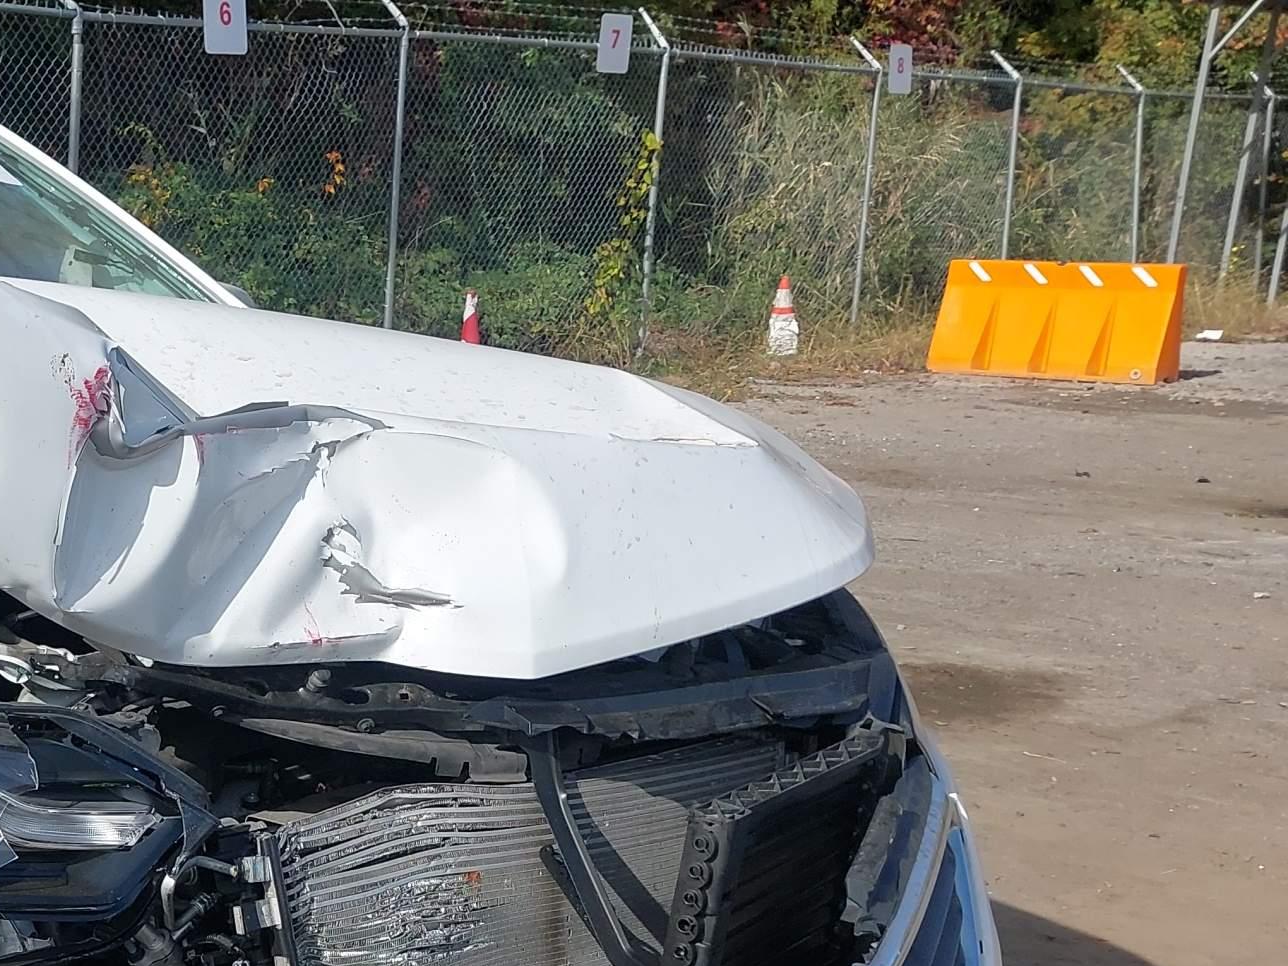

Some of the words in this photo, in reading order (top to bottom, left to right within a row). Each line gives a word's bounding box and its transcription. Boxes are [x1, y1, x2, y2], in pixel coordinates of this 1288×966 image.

[219, 1, 232, 26] 6
[611, 29, 621, 49] 7
[897, 57, 905, 74] 8
